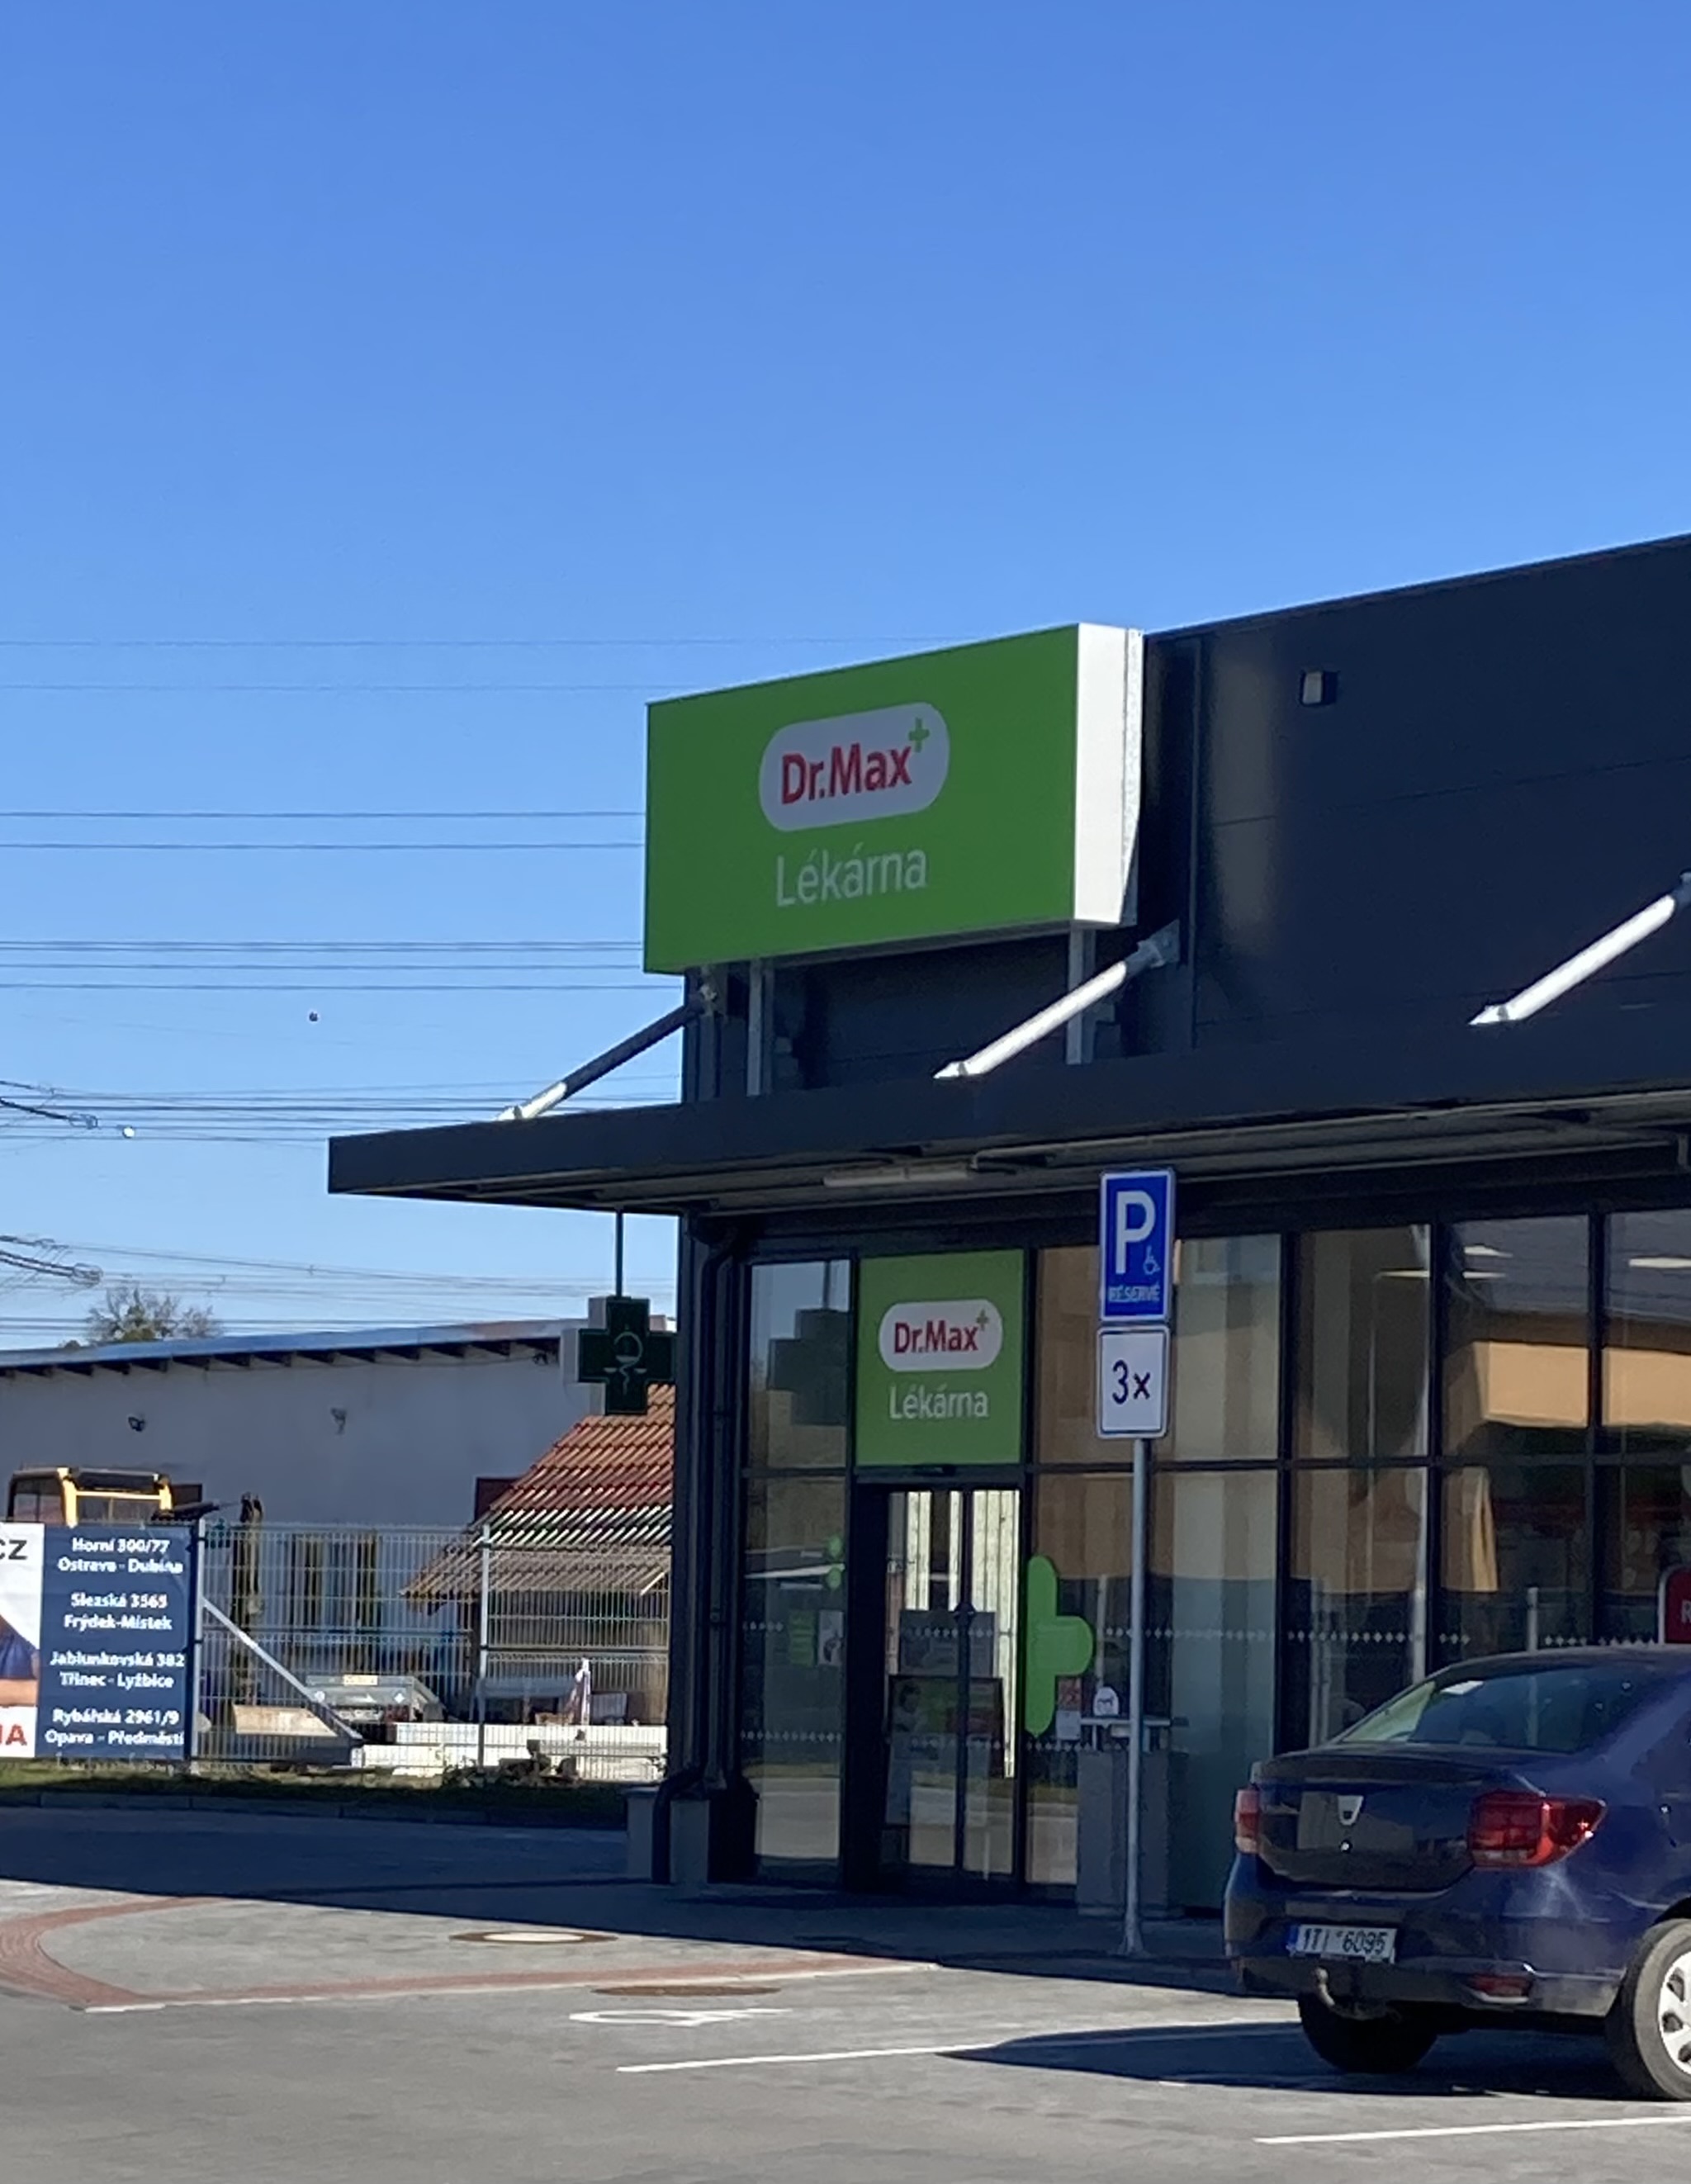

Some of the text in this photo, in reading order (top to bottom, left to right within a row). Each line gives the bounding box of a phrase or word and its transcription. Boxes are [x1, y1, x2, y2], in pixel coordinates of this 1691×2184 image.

[781, 742, 912, 806] Dr.Max
[776, 841, 928, 907] Lékárna
[1115, 1190, 1156, 1274] P
[893, 1319, 978, 1354] Dr.Max
[888, 1382, 990, 1419] Lékárna
[1112, 1359, 1151, 1405] 3x
[57, 1556, 116, 1573] Ostrava
[45, 1729, 94, 1747] Opava
[1343, 1931, 1388, 1954] 6095
